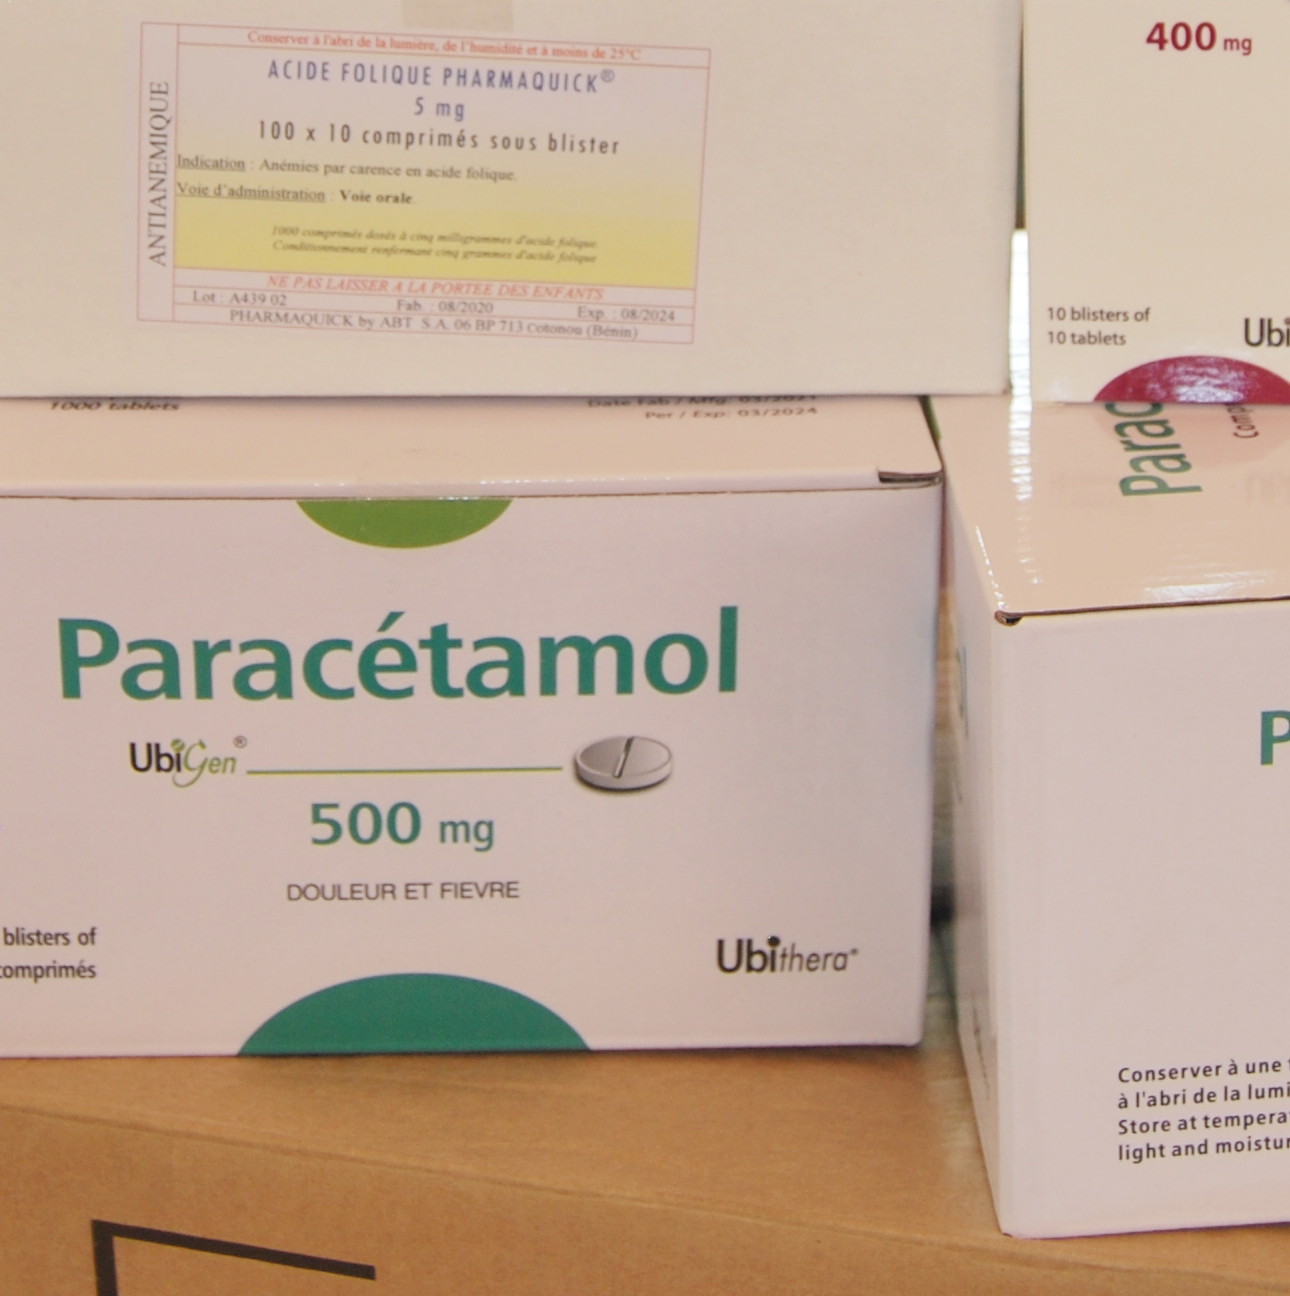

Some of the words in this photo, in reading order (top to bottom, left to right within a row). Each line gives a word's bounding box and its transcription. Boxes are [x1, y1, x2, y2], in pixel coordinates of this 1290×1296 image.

[248, 30, 308, 45] Conserver
[313, 33, 320, 45] à
[357, 34, 370, 47] de
[375, 35, 386, 48] la
[443, 40, 456, 52] de
[527, 45, 537, 55] et
[592, 47, 606, 59] de
[1146, 21, 1216, 51] 400
[1223, 35, 1252, 56] mg
[268, 60, 330, 80] ACIDE
[341, 62, 431, 85] FOLIQUE
[414, 97, 424, 115] 5
[436, 102, 465, 122] mg
[259, 120, 295, 140] 100
[306, 127, 316, 141] x
[329, 123, 351, 142] 10
[362, 128, 478, 150] comprimés
[490, 133, 537, 151] sous
[548, 132, 620, 155] blister
[148, 81, 171, 266] ANTIANEMIQUE
[176, 155, 245, 171] Indication
[324, 163, 344, 176] par
[349, 165, 401, 177] carence
[406, 168, 421, 177] en
[425, 166, 461, 179] acide
[176, 182, 209, 197] Voie
[339, 189, 371, 203] Voie
[193, 291, 216, 303] Lot
[267, 275, 289, 288] NE
[292, 276, 322, 290] PAS
[325, 277, 388, 292] LAISSER
[407, 282, 427, 294] LA
[498, 284, 528, 297] DES
[532, 286, 605, 301] ENFANTS
[229, 309, 353, 327] PHARMAQUICK
[358, 315, 375, 331] by
[475, 320, 495, 332] BP
[1047, 307, 1065, 321] 10
[1070, 306, 1130, 322] blisters
[1134, 306, 1151, 321] of
[1047, 331, 1066, 345] 10
[1070, 330, 1126, 346] tablets
[57, 605, 740, 703] Paracétamol
[309, 801, 421, 845] 500
[438, 813, 496, 852] mg
[286, 882, 398, 902] DOULEUR
[404, 882, 432, 900] ET
[439, 880, 520, 901] FIEVRE
[2, 925, 72, 948] blisters
[76, 925, 97, 946] of
[1118, 1063, 1222, 1083] Conserver
[1227, 1058, 1238, 1075] à
[1245, 1060, 1282, 1074] une
[1118, 1093, 1128, 1110] à
[1135, 1089, 1187, 1108] l'abri
[1193, 1087, 1217, 1104] de
[1223, 1085, 1241, 1101] la
[1118, 1118, 1171, 1135] Store
[1177, 1115, 1196, 1131] at
[1118, 1143, 1166, 1164] light
[1171, 1139, 1208, 1157] and
